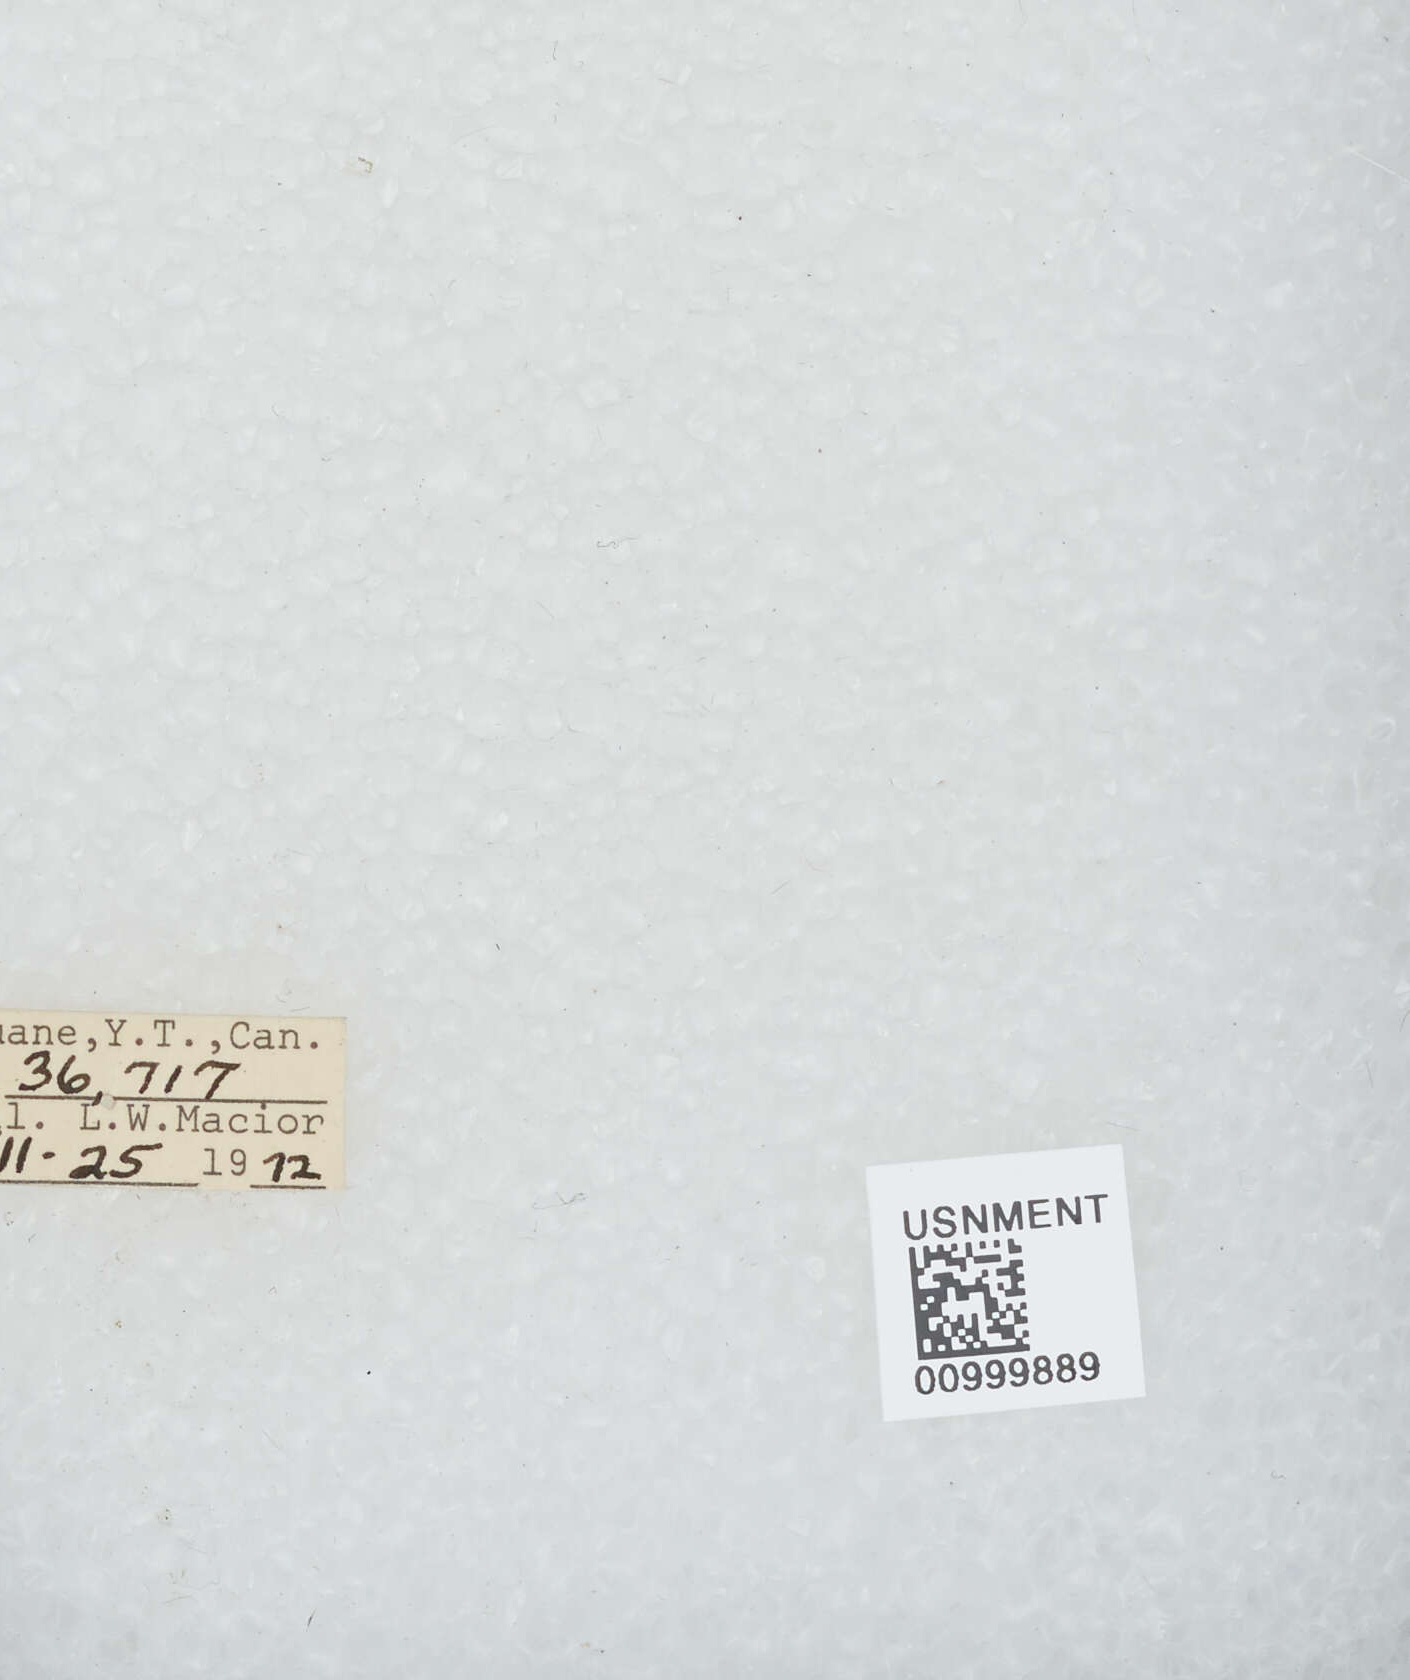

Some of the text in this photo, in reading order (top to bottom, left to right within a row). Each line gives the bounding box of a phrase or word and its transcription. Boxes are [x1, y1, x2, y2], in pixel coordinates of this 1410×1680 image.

[79, 1103, 325, 1135] L.W.Macior
[902, 1193, 1108, 1240] USNMENT
[914, 1351, 1100, 1395] 00999889
